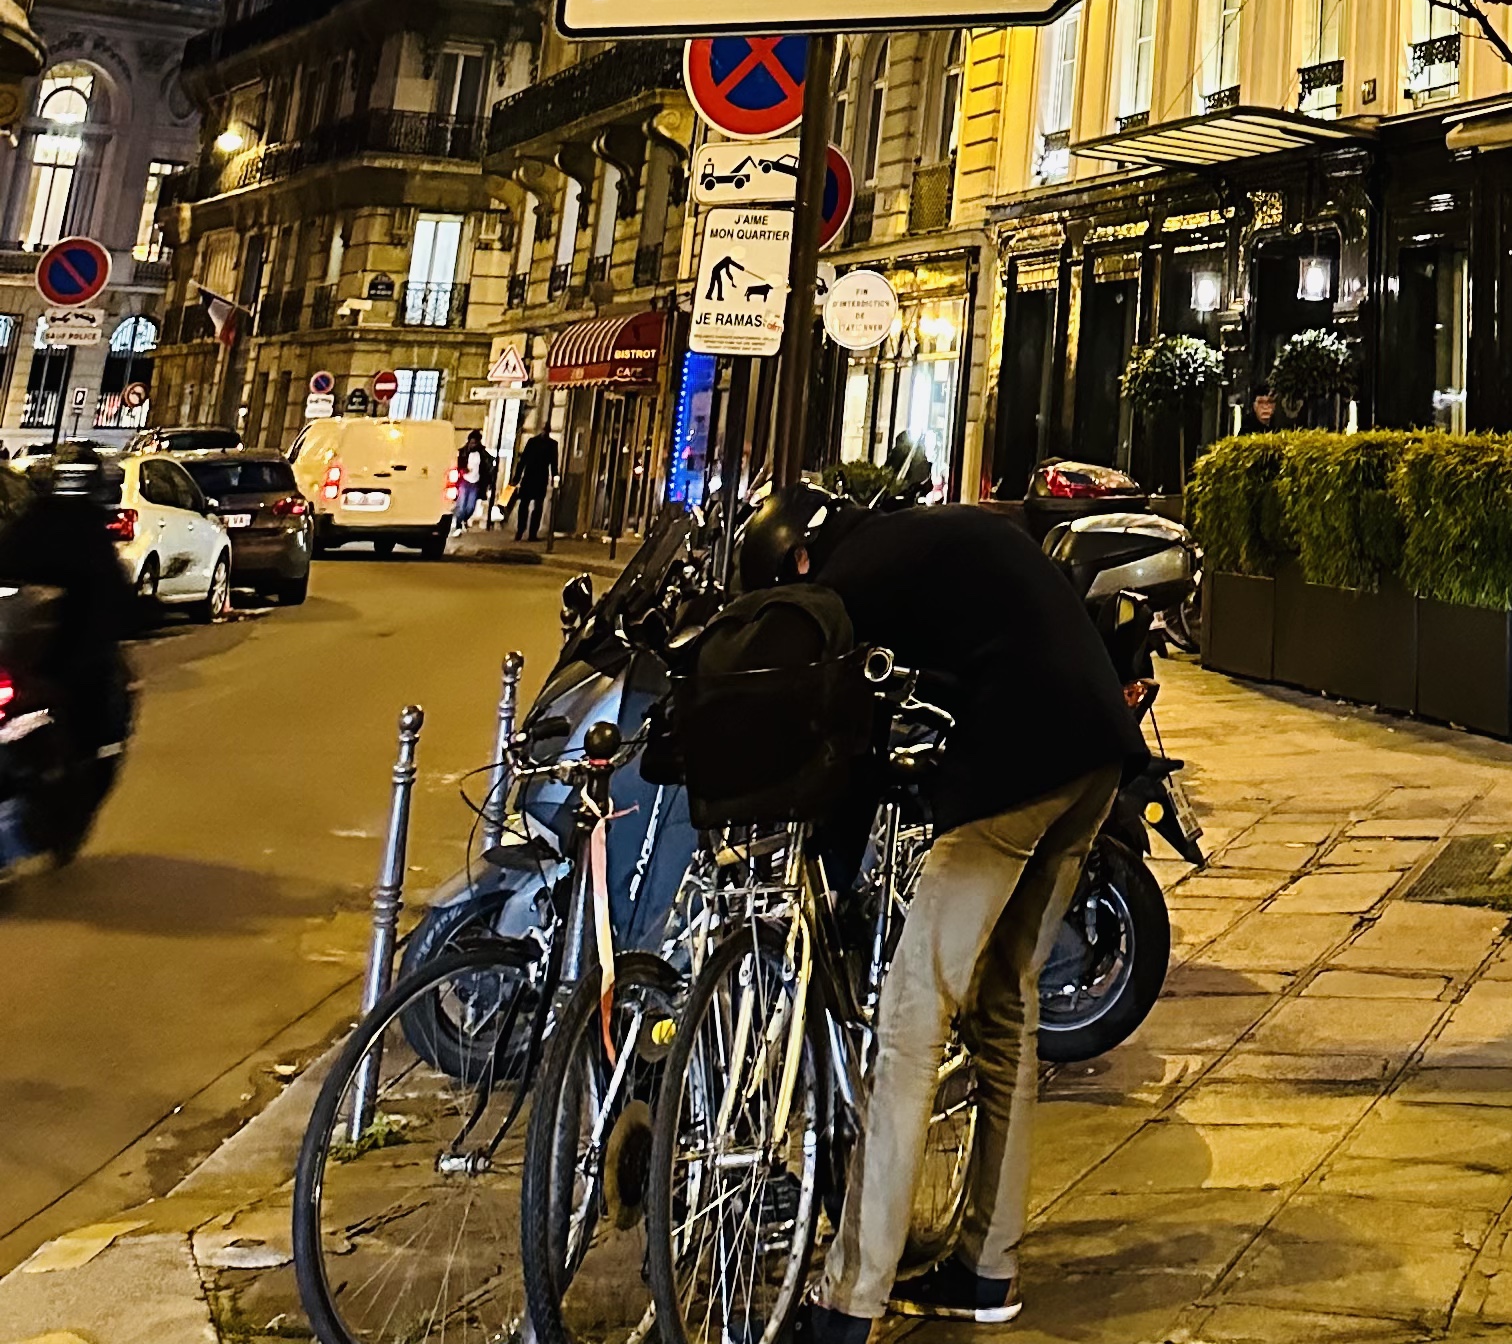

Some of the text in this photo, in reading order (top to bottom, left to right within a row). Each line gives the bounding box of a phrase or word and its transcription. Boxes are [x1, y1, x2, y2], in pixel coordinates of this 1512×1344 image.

[734, 214, 769, 225] J'AIME
[710, 228, 790, 241] MON QUARTIER
[695, 312, 712, 325] JE
[614, 349, 657, 359] BISTROT
